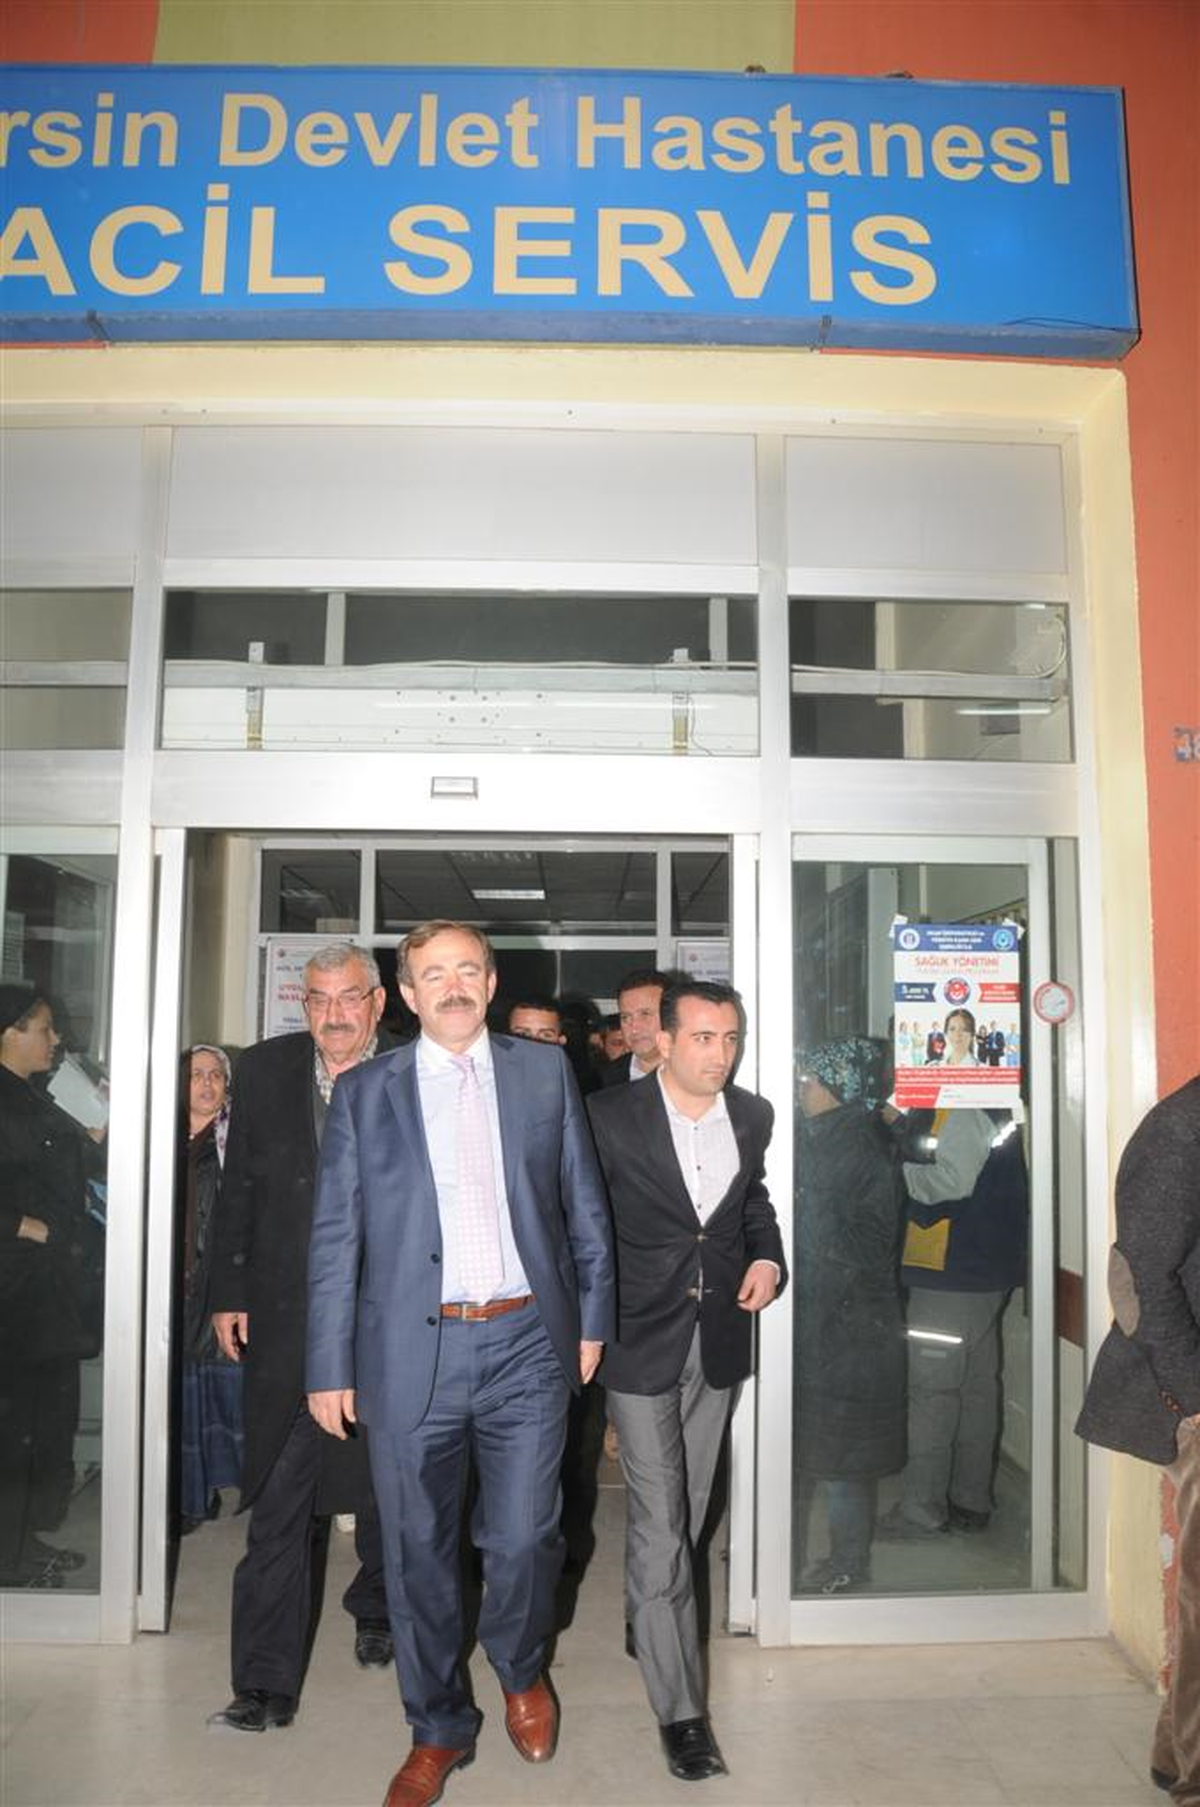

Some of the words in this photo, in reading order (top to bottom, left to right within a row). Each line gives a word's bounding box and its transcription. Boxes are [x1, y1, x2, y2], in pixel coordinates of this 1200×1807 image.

[219, 93, 539, 168] Devlet
[576, 96, 1070, 185] Hastanesi
[0, 183, 326, 296] ACİL
[384, 191, 937, 305] SERVİS
